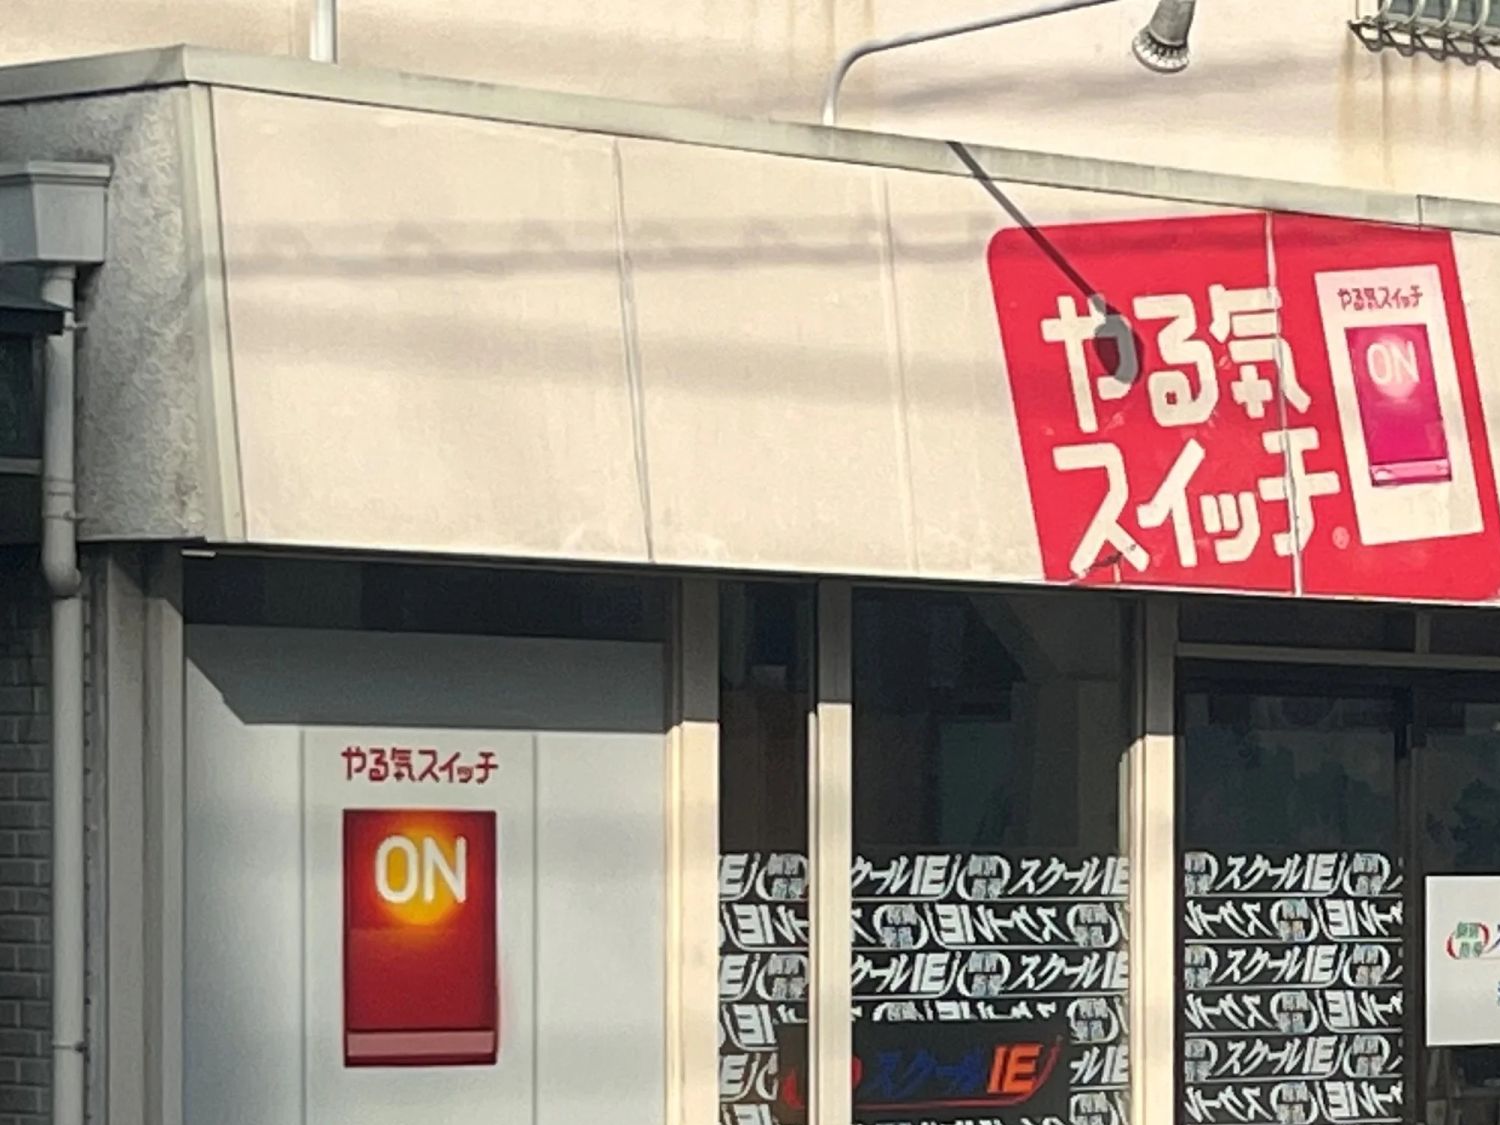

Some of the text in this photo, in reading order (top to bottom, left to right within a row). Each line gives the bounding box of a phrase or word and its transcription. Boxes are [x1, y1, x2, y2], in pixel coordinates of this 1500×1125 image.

[1041, 284, 1311, 433] やる気
[1366, 341, 1420, 386] ON
[1052, 427, 1341, 577] スイッチ
[341, 746, 499, 784] やる気スイッチ
[375, 834, 467, 904] ON
